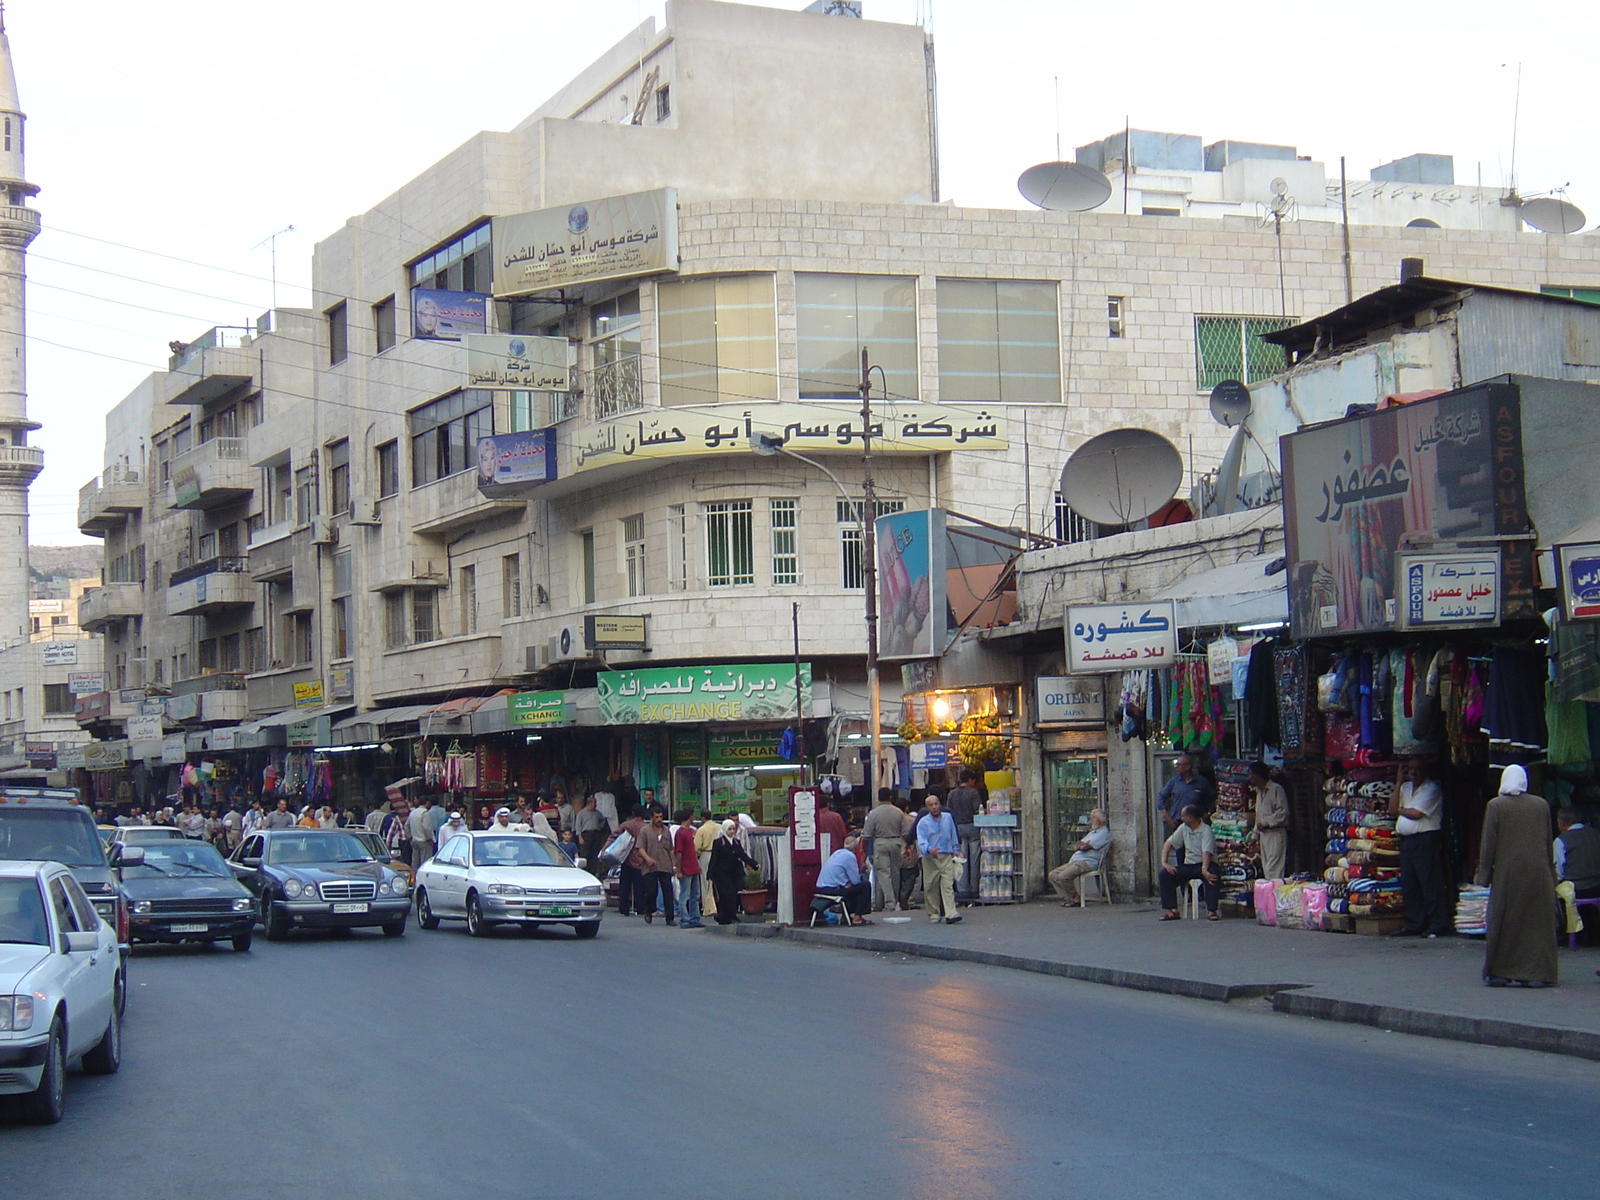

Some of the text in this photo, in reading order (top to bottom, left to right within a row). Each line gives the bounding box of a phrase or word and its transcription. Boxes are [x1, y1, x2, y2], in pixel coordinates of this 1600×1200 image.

[626, 224, 659, 244] شركة
[569, 235, 586, 257] أبو
[589, 236, 625, 253] موسى
[503, 245, 535, 268] للشحن
[506, 359, 531, 372] شركة
[471, 370, 497, 385] للشحن
[523, 372, 535, 386] أبو
[537, 376, 564, 387] موسى
[576, 410, 997, 466] شركة موسى أبو حسّان للشحن
[1414, 411, 1481, 453] شركة خليل
[1496, 405, 1519, 525] ASFOUR
[1315, 449, 1411, 524] عصفور
[1439, 567, 1476, 579] شركة
[1410, 567, 1423, 620] ASFOUR
[1427, 583, 1492, 602] خليل عصفور
[1073, 609, 1170, 643] كشوره
[618, 668, 777, 701] ديرانية للصرافة
[514, 697, 562, 710] صرافة
[1044, 691, 1101, 706] ORIENT
[514, 710, 564, 721] EXCHANGE
[640, 701, 742, 721] EXCHANGE
[1063, 709, 1086, 717] JAPAN
[720, 746, 778, 757] EXCHAN
